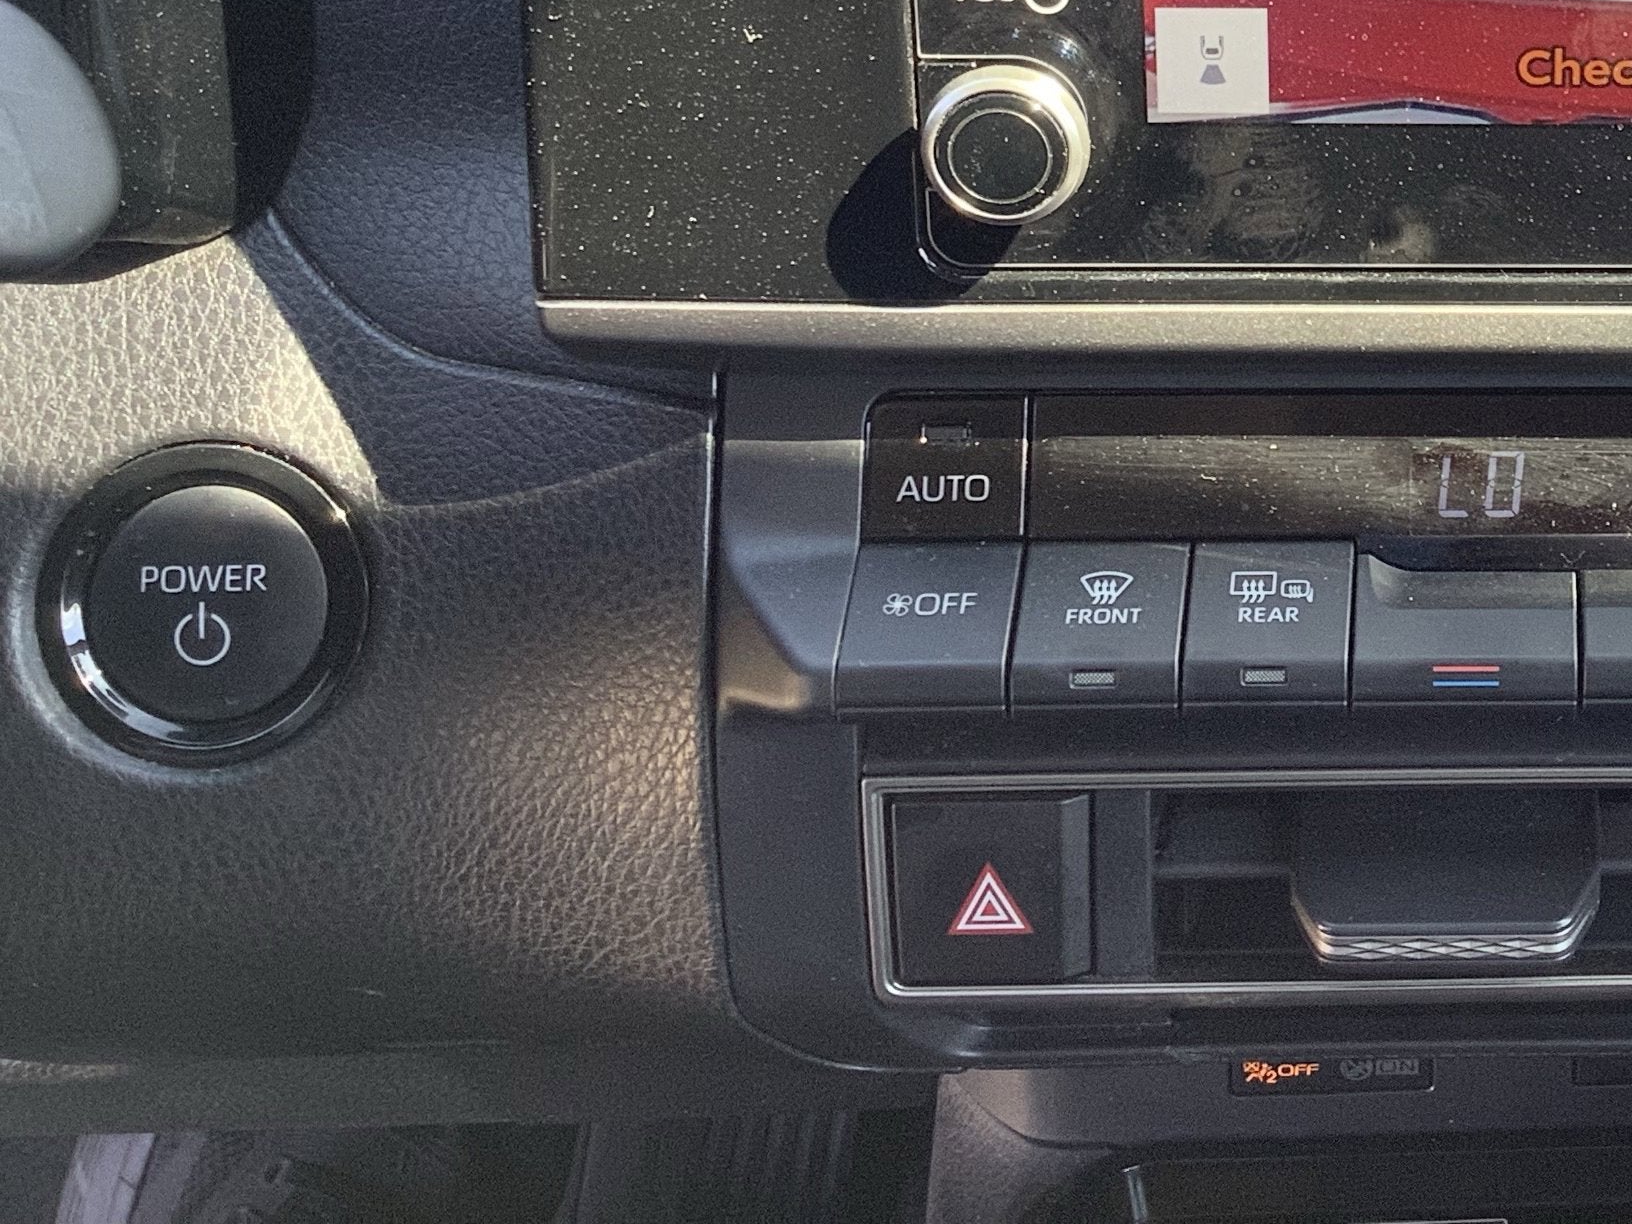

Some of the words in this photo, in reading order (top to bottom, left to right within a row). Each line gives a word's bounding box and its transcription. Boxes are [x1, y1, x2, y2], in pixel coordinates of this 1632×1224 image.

[896, 474, 990, 502] AUTO
[140, 564, 267, 593] POWER
[914, 591, 977, 616] OFF
[1065, 607, 1142, 624] FRONT
[1237, 606, 1300, 623] REAR
